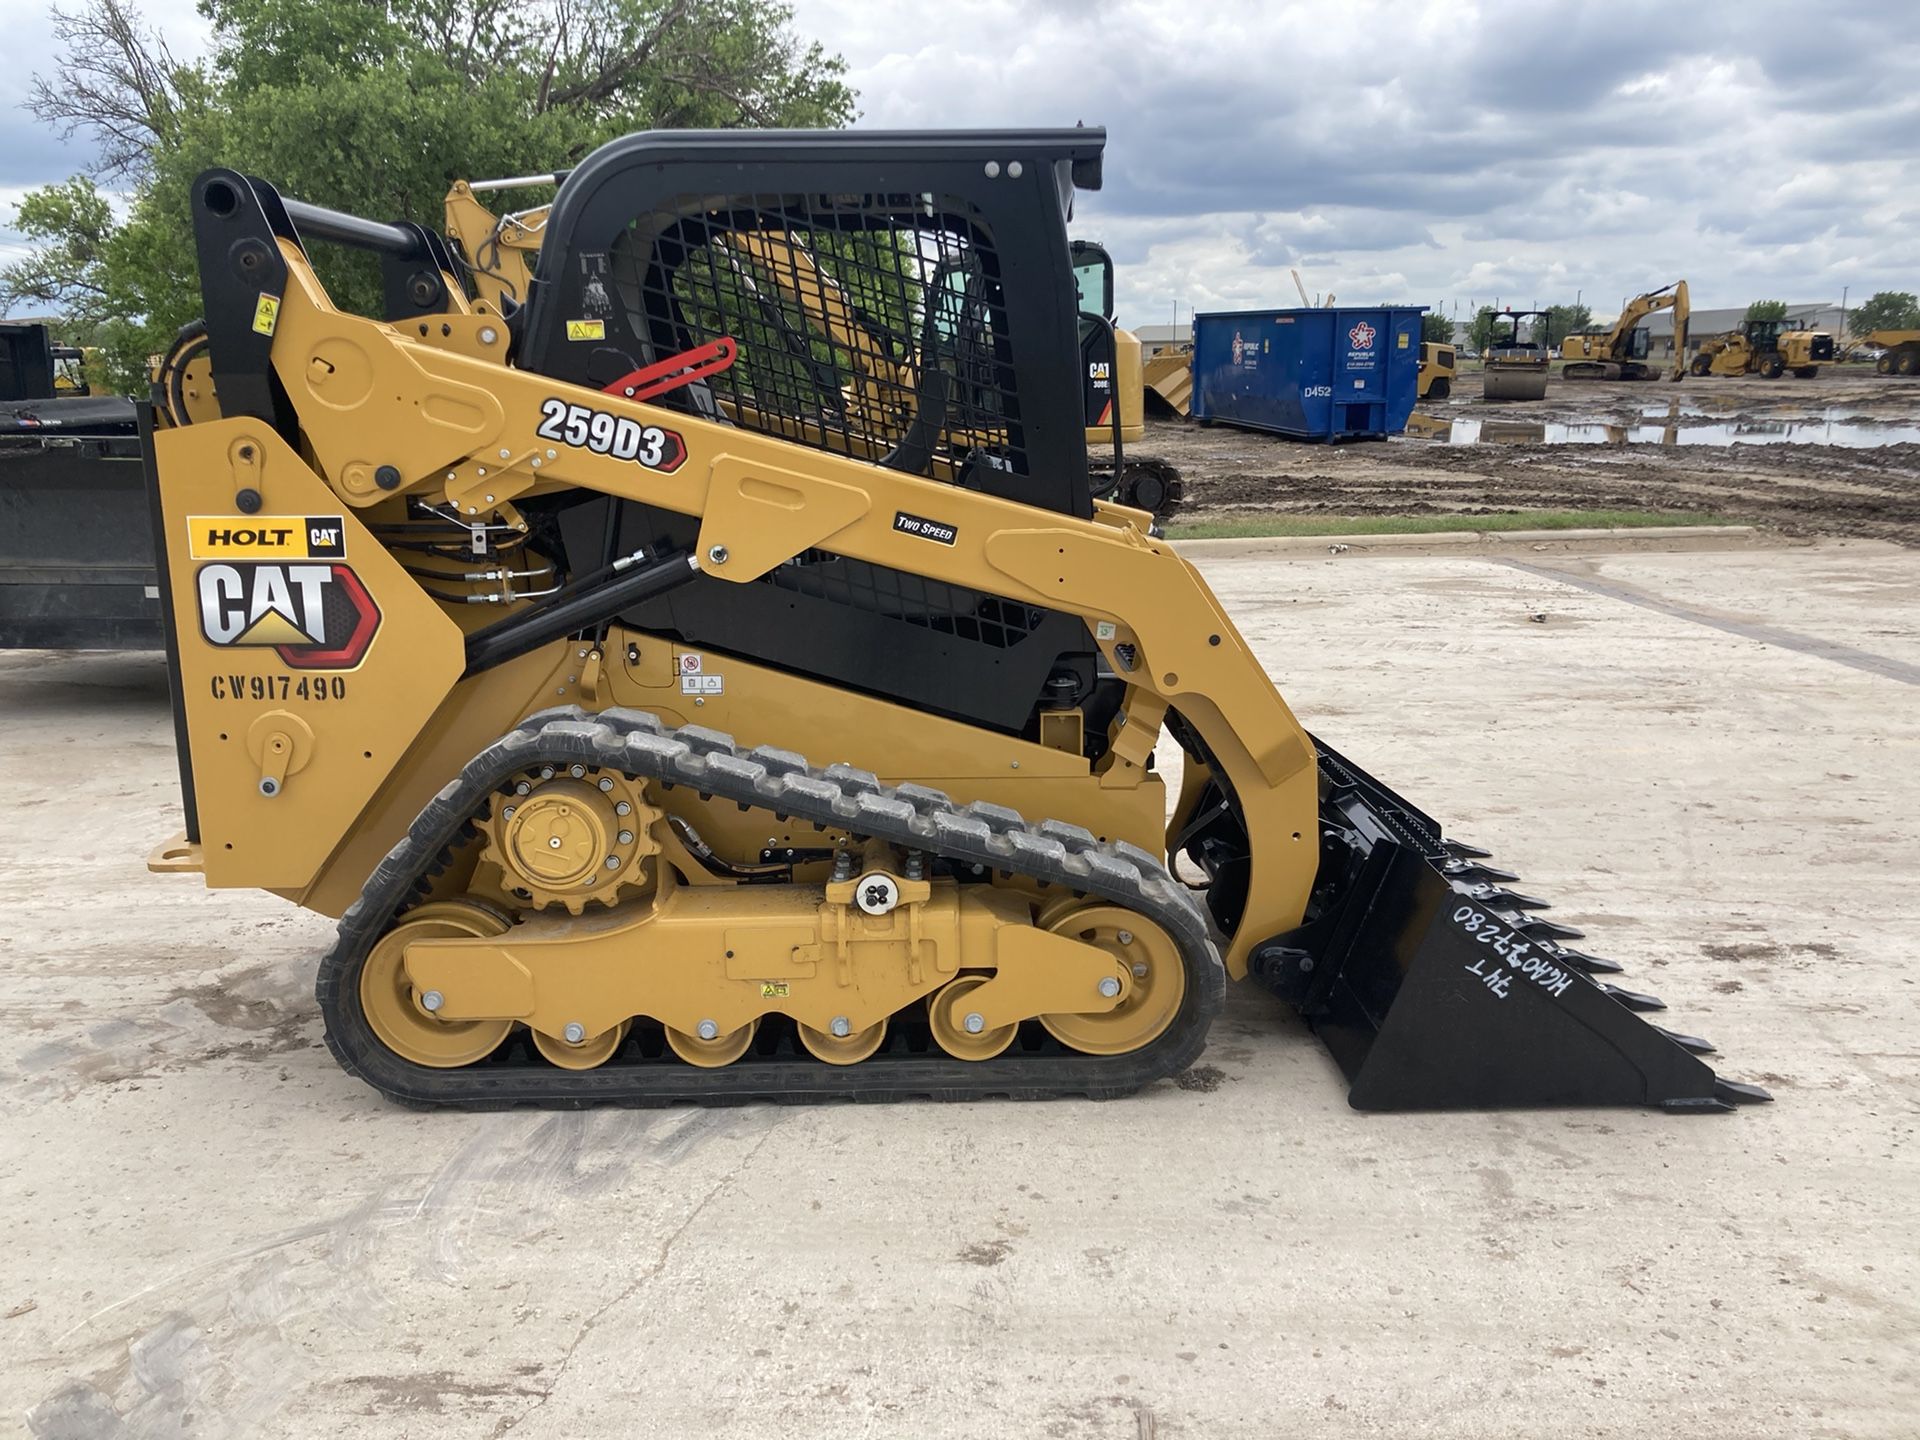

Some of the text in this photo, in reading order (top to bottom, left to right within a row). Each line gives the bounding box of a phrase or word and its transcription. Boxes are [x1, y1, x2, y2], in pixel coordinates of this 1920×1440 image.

[1089, 362, 1110, 378] CAT
[1304, 386, 1332, 397] D452
[537, 399, 666, 467] 259D3
[208, 528, 338, 546] HOLT CAT
[199, 564, 333, 644] CAT
[211, 675, 346, 701] CW917490
